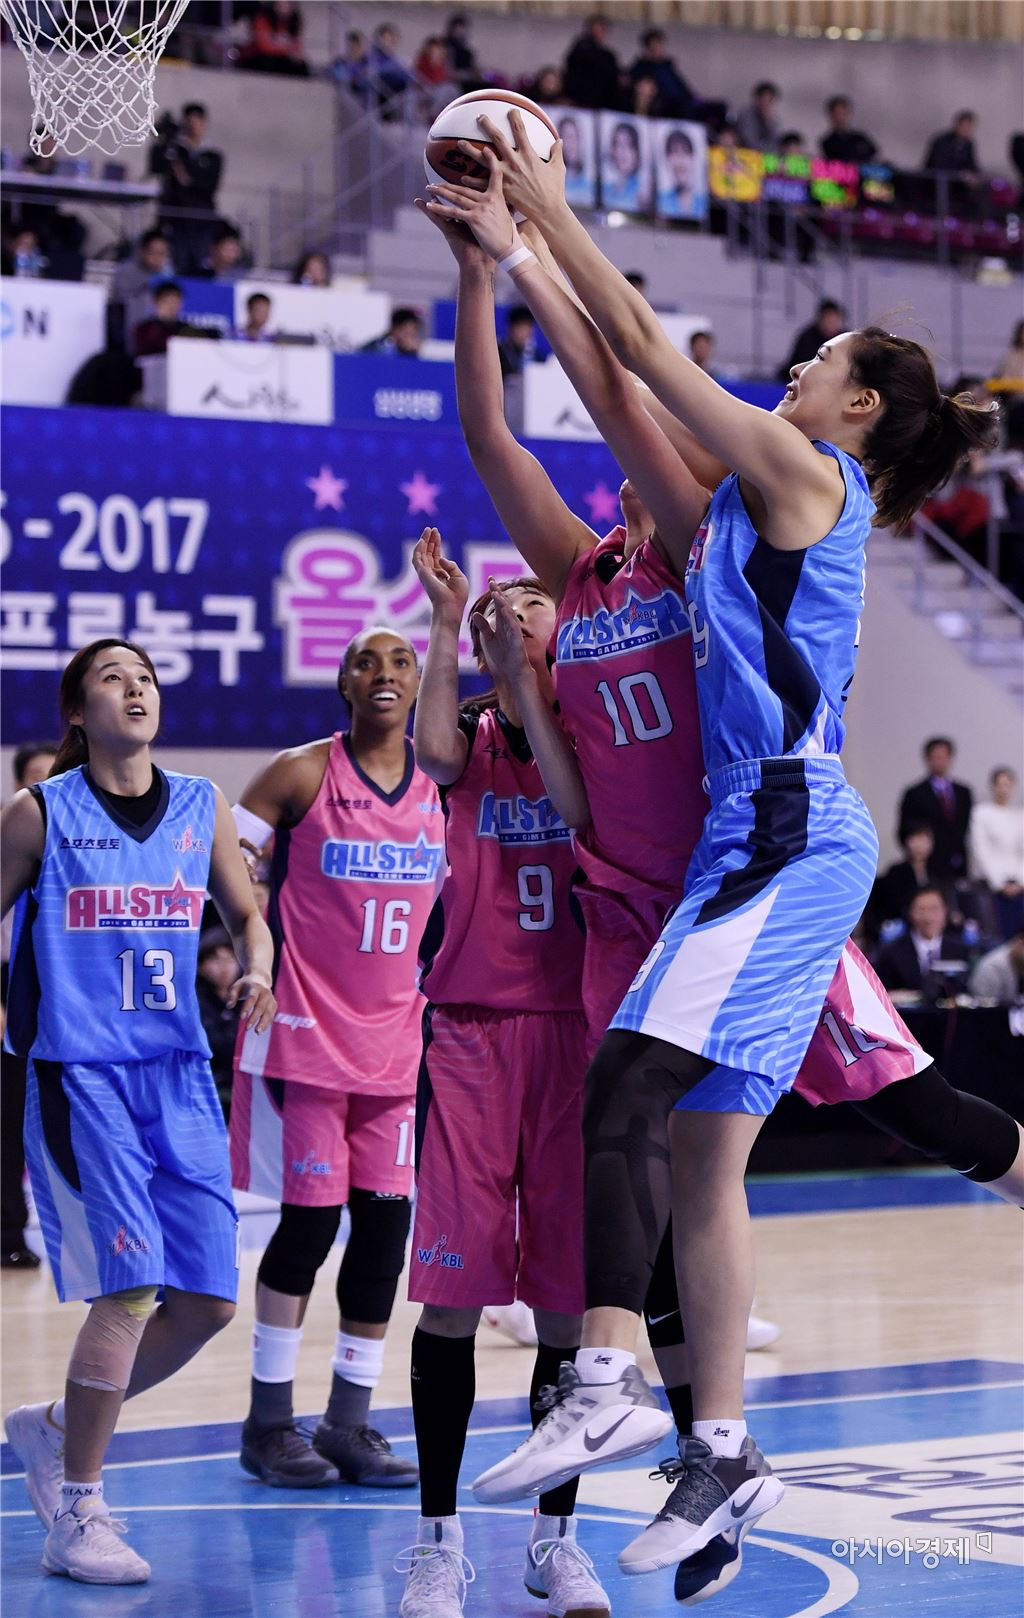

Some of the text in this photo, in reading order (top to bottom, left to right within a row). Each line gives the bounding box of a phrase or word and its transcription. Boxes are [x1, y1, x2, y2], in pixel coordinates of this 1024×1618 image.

[597, 643, 627, 655] GAME
[596, 671, 674, 747] 10
[359, 898, 412, 955] 16
[517, 864, 554, 932] 9
[117, 948, 177, 1012] 13
[417, 1247, 464, 1269] WKBL
